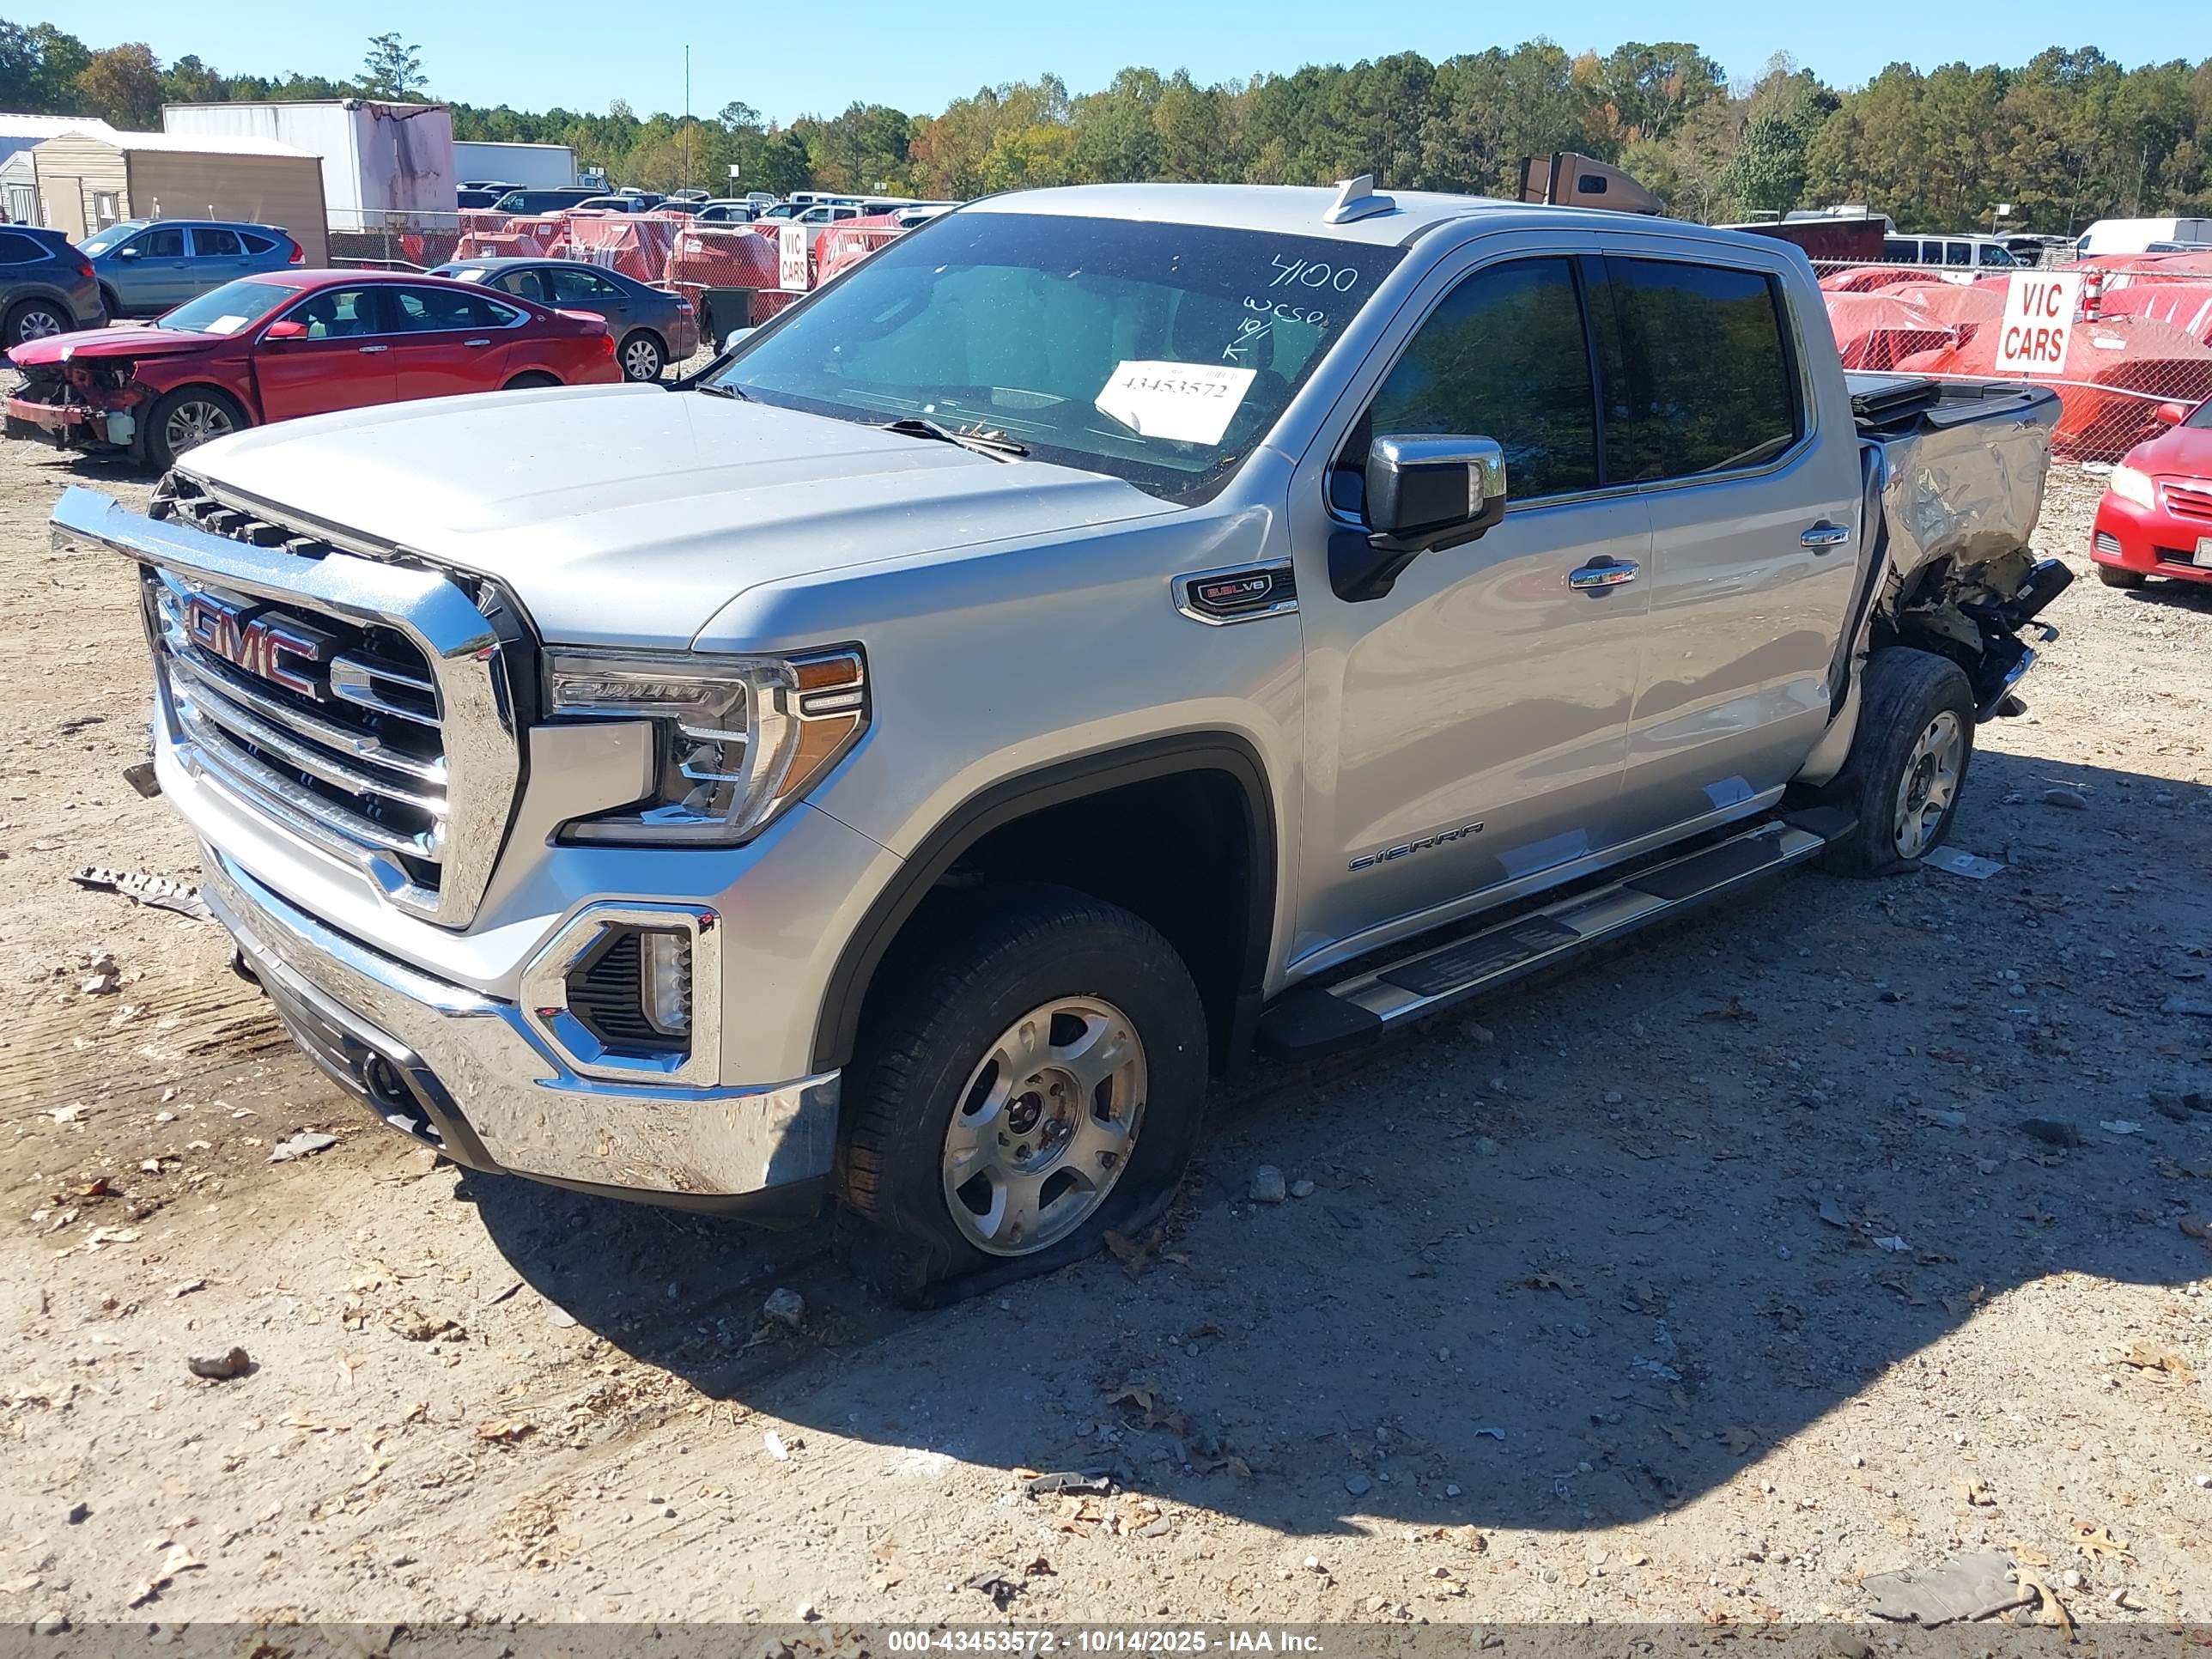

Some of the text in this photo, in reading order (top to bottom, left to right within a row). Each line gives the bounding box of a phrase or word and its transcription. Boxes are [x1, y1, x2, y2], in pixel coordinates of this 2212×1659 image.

[785, 233, 801, 254] VIC
[782, 260, 805, 283] CARS
[1269, 253, 1358, 292] 4100
[2023, 283, 2063, 318] VIC
[2005, 326, 2063, 362] CARS
[185, 592, 318, 700] GMC
[1347, 821, 1485, 872] SIERRA
